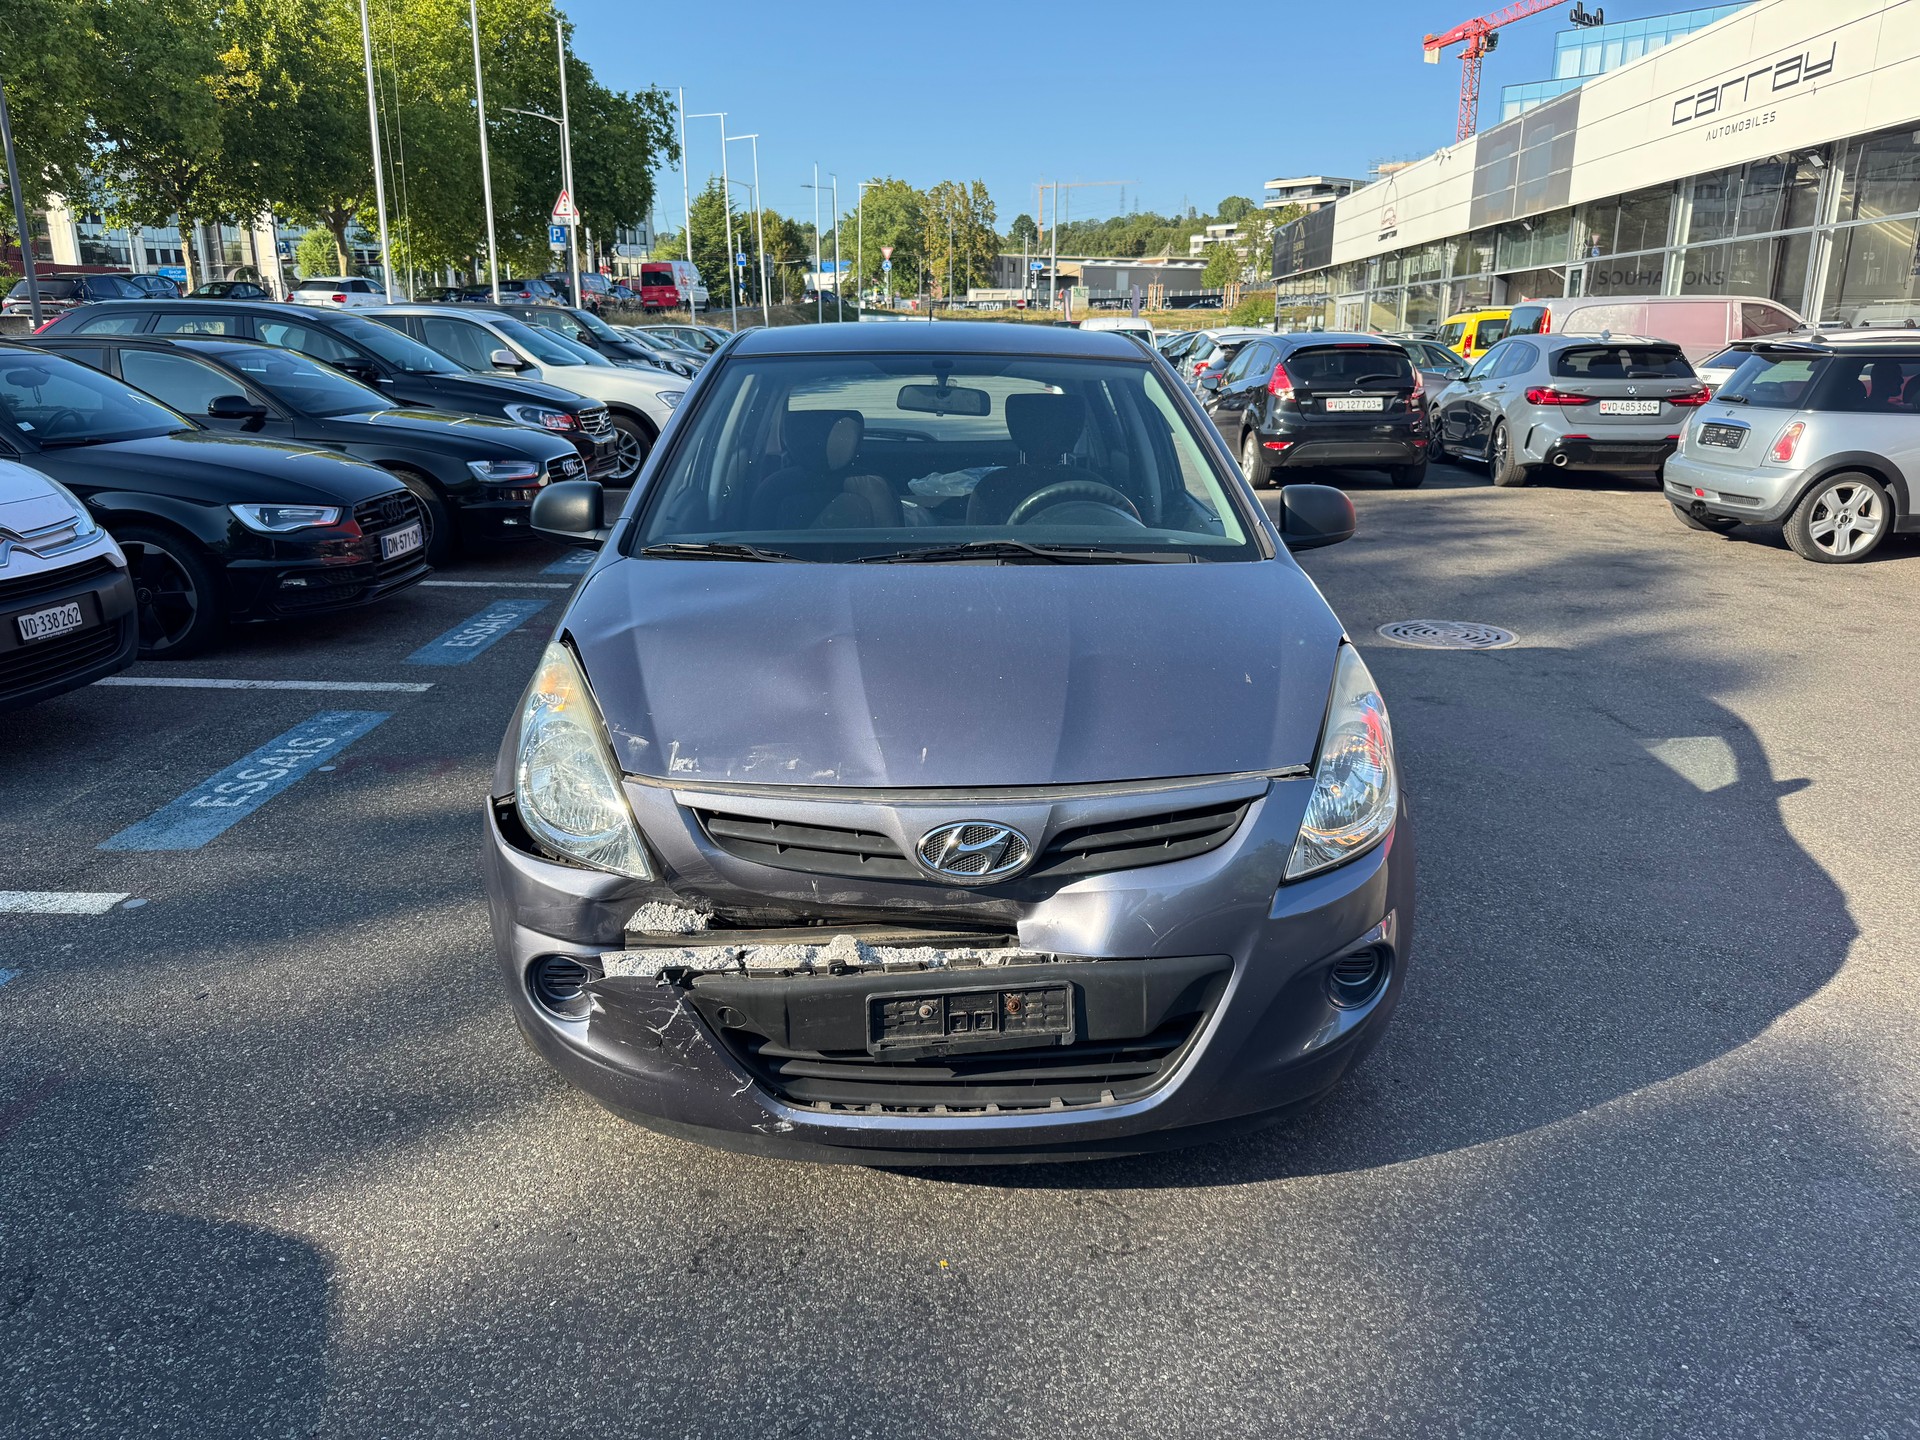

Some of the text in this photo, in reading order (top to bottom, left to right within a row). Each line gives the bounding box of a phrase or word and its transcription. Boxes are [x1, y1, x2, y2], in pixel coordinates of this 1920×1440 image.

[1672, 41, 1837, 126] carray
[1705, 111, 1777, 141] AUTOMOBILES
[553, 228, 560, 241] P
[1597, 270, 1725, 286] SOUHAONS
[441, 613, 519, 647] ESSAIS
[189, 737, 336, 808] ESSAIS
